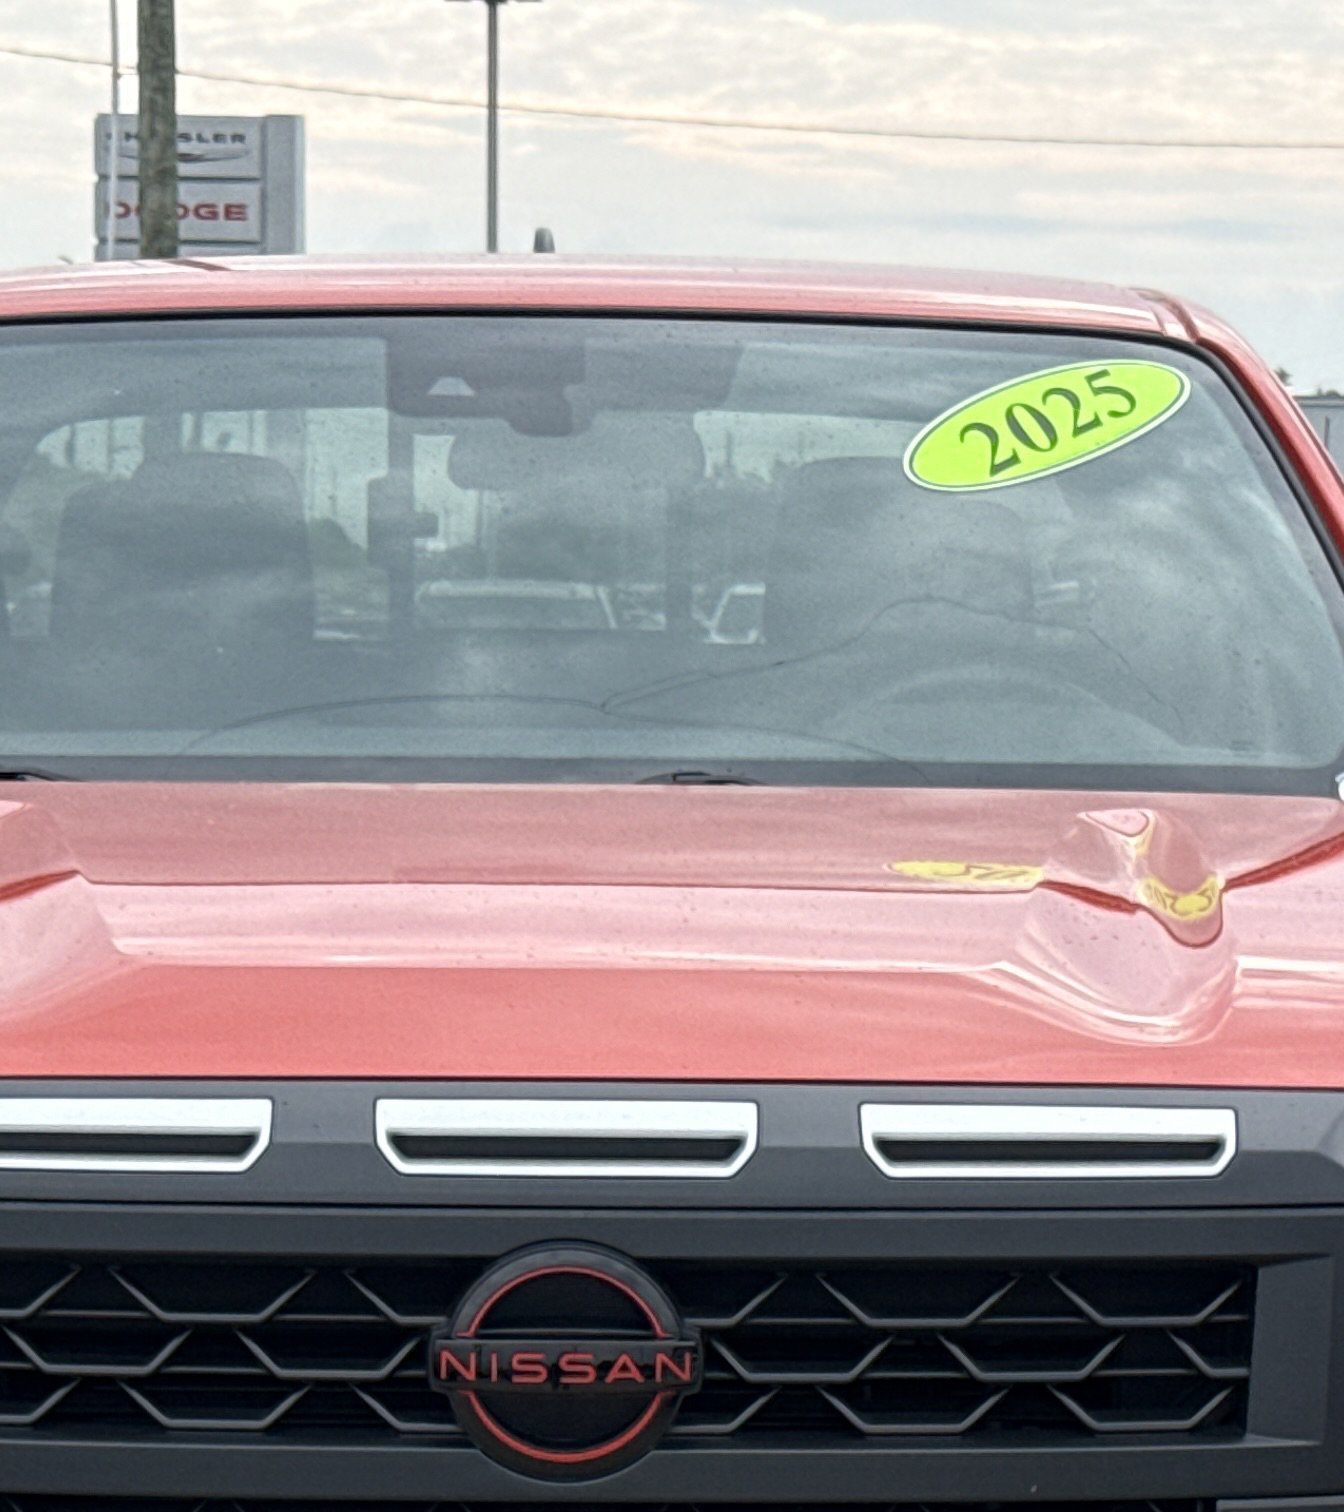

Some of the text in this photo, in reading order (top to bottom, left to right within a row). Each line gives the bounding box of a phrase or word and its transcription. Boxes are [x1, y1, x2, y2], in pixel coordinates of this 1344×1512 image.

[106, 202, 248, 221] DDGE
[959, 369, 1137, 477] 2025
[438, 1349, 693, 1384] NISSAN
